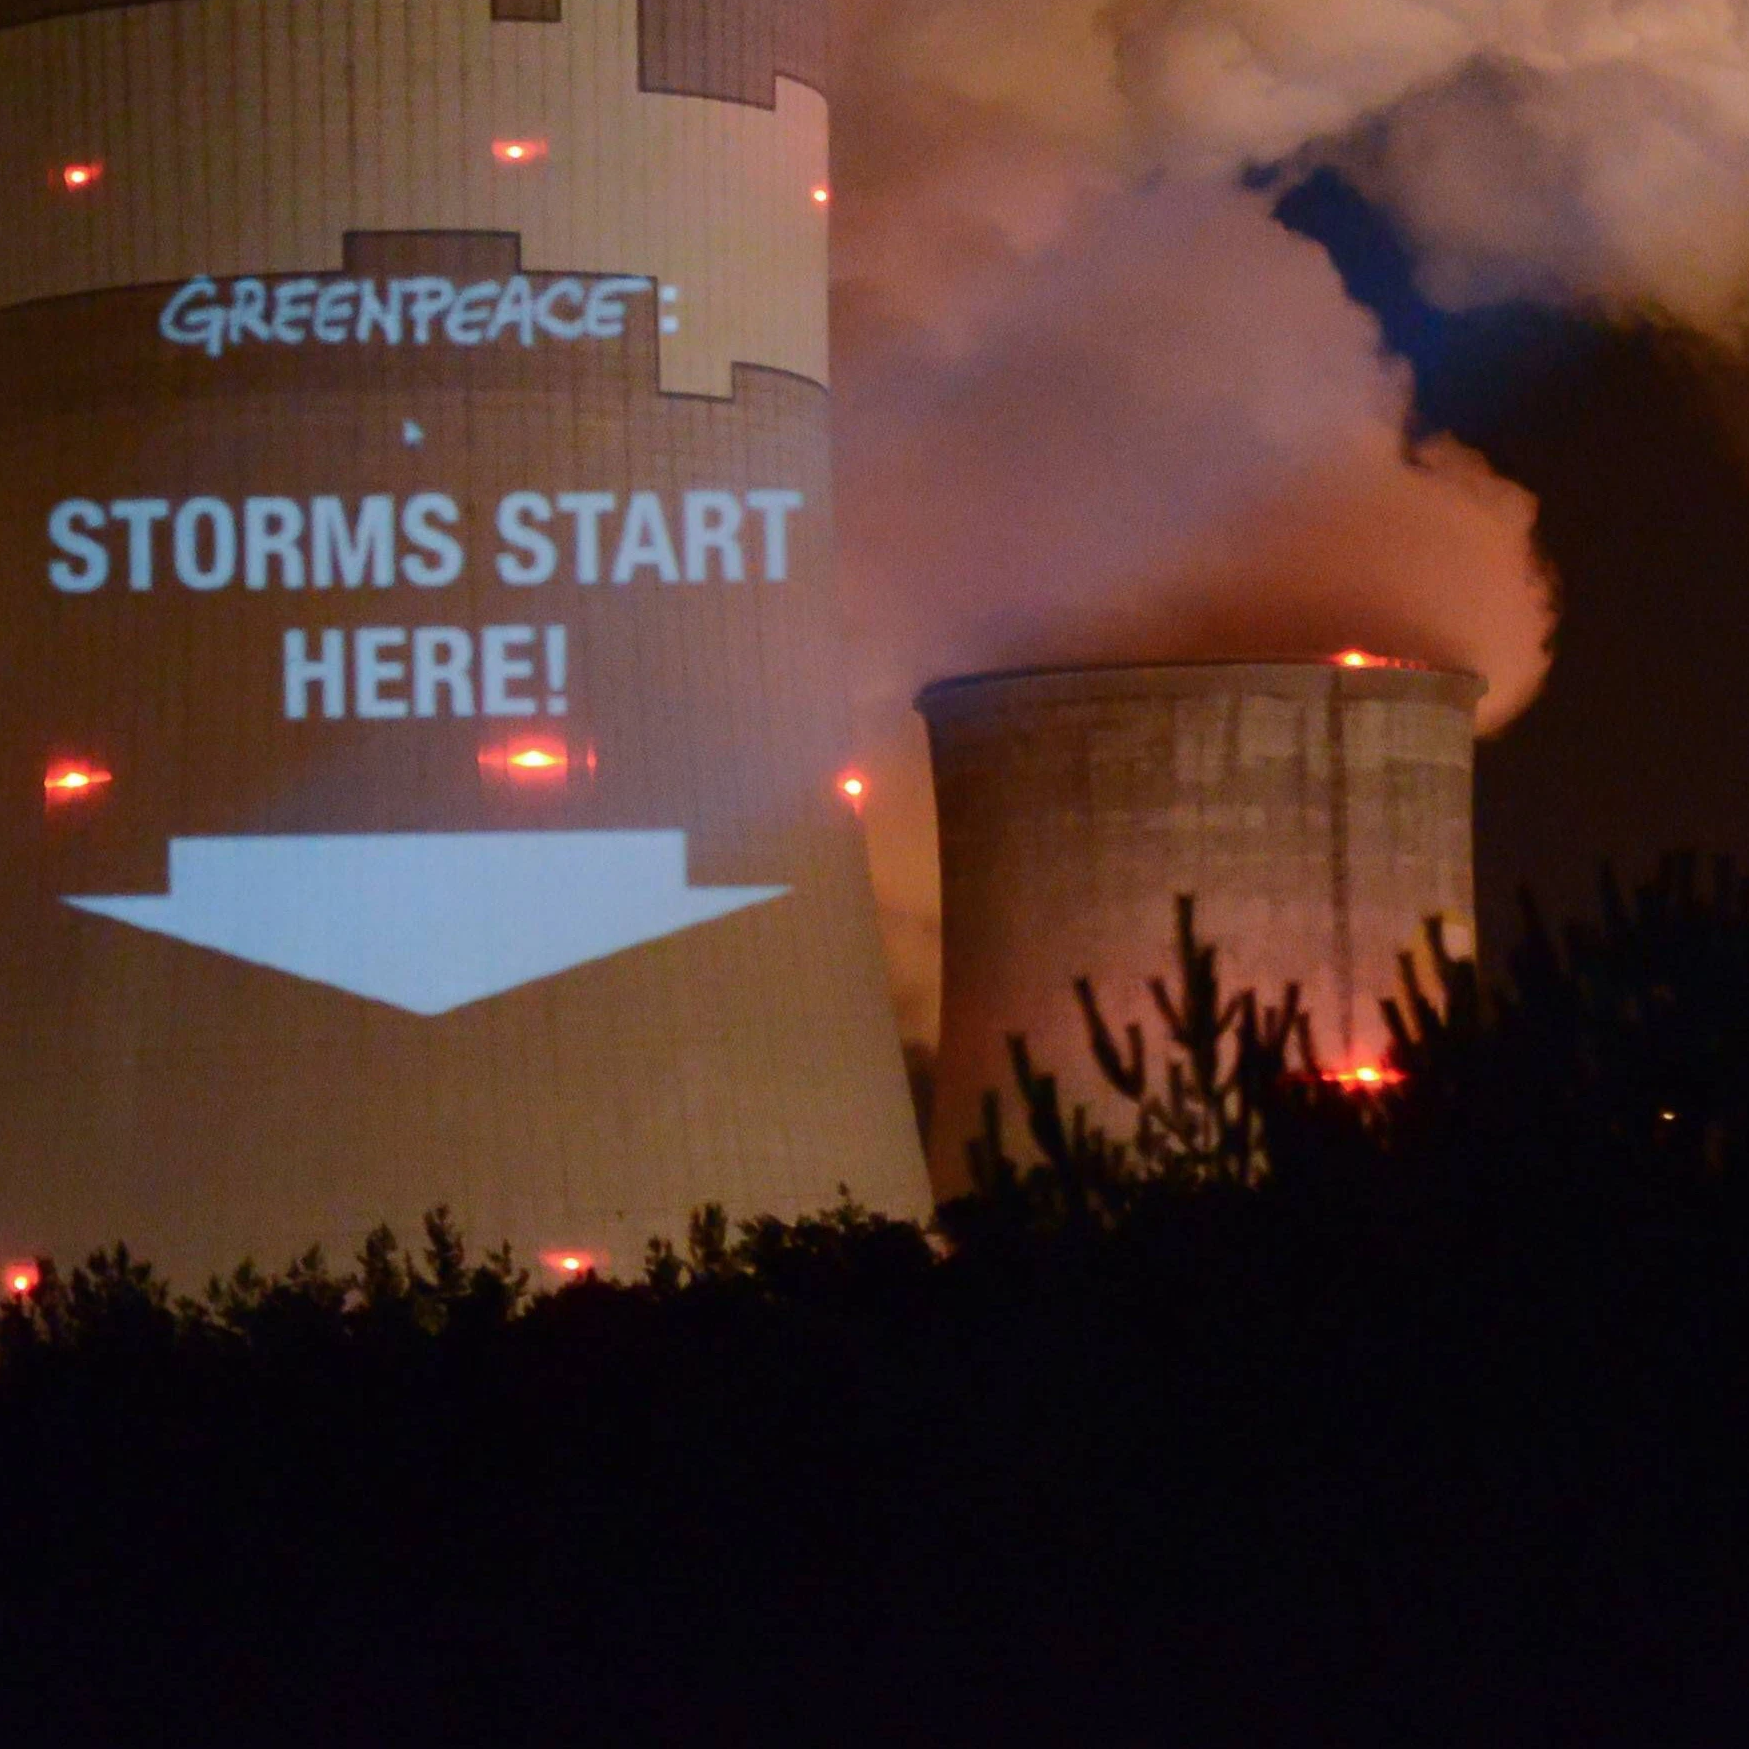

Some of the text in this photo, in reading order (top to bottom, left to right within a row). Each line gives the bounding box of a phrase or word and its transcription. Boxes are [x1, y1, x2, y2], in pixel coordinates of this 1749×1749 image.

[48, 490, 804, 594] STORMS START
[282, 623, 570, 721] HERE!
